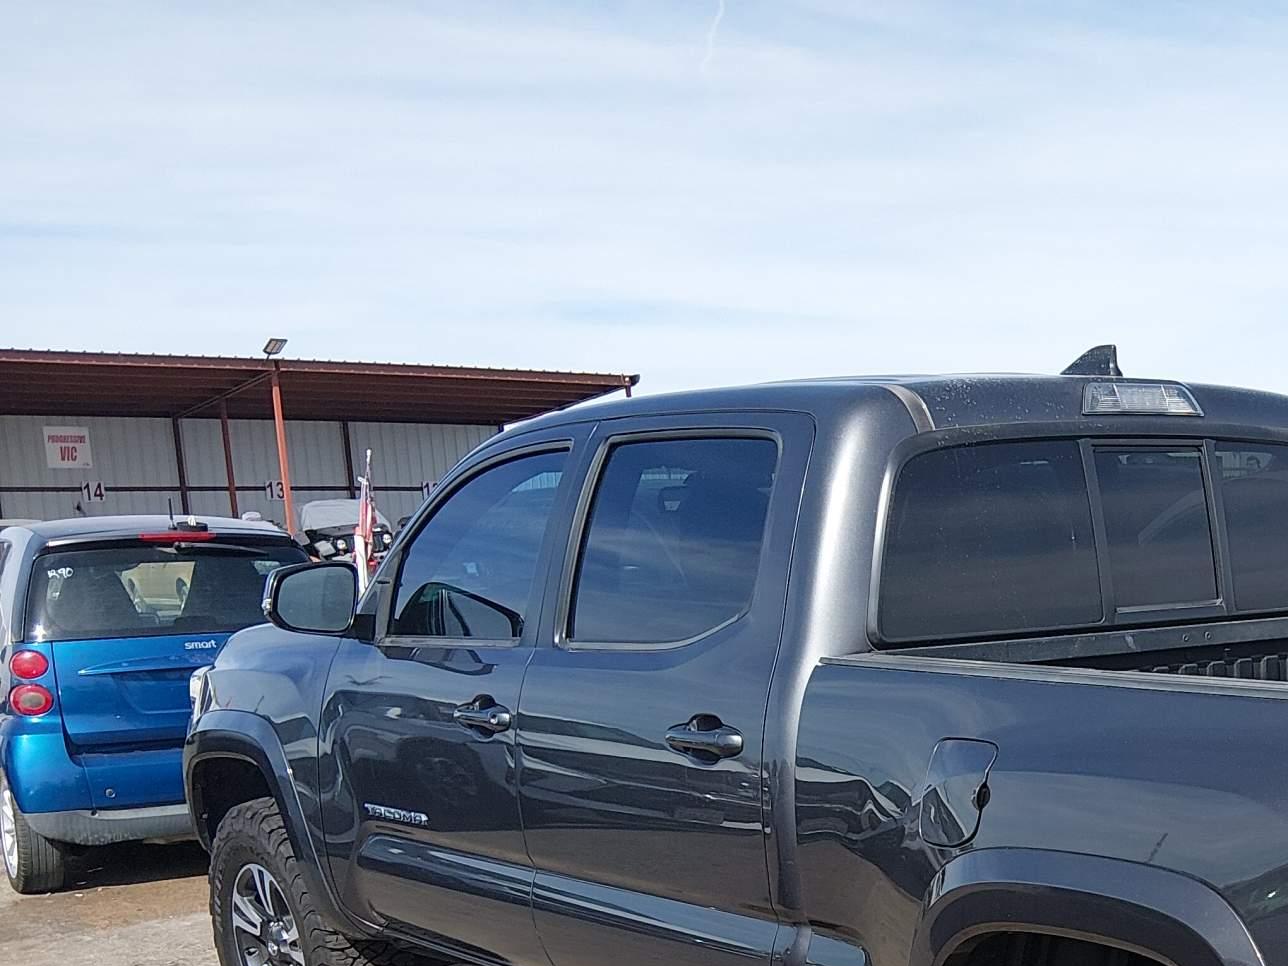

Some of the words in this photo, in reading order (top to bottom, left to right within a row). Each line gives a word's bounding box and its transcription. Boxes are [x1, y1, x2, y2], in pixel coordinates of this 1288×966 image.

[60, 446, 78, 462] VIC
[83, 481, 104, 501] 14
[266, 481, 285, 499] 13
[184, 640, 217, 650] smart
[364, 803, 429, 826] TACOMA
